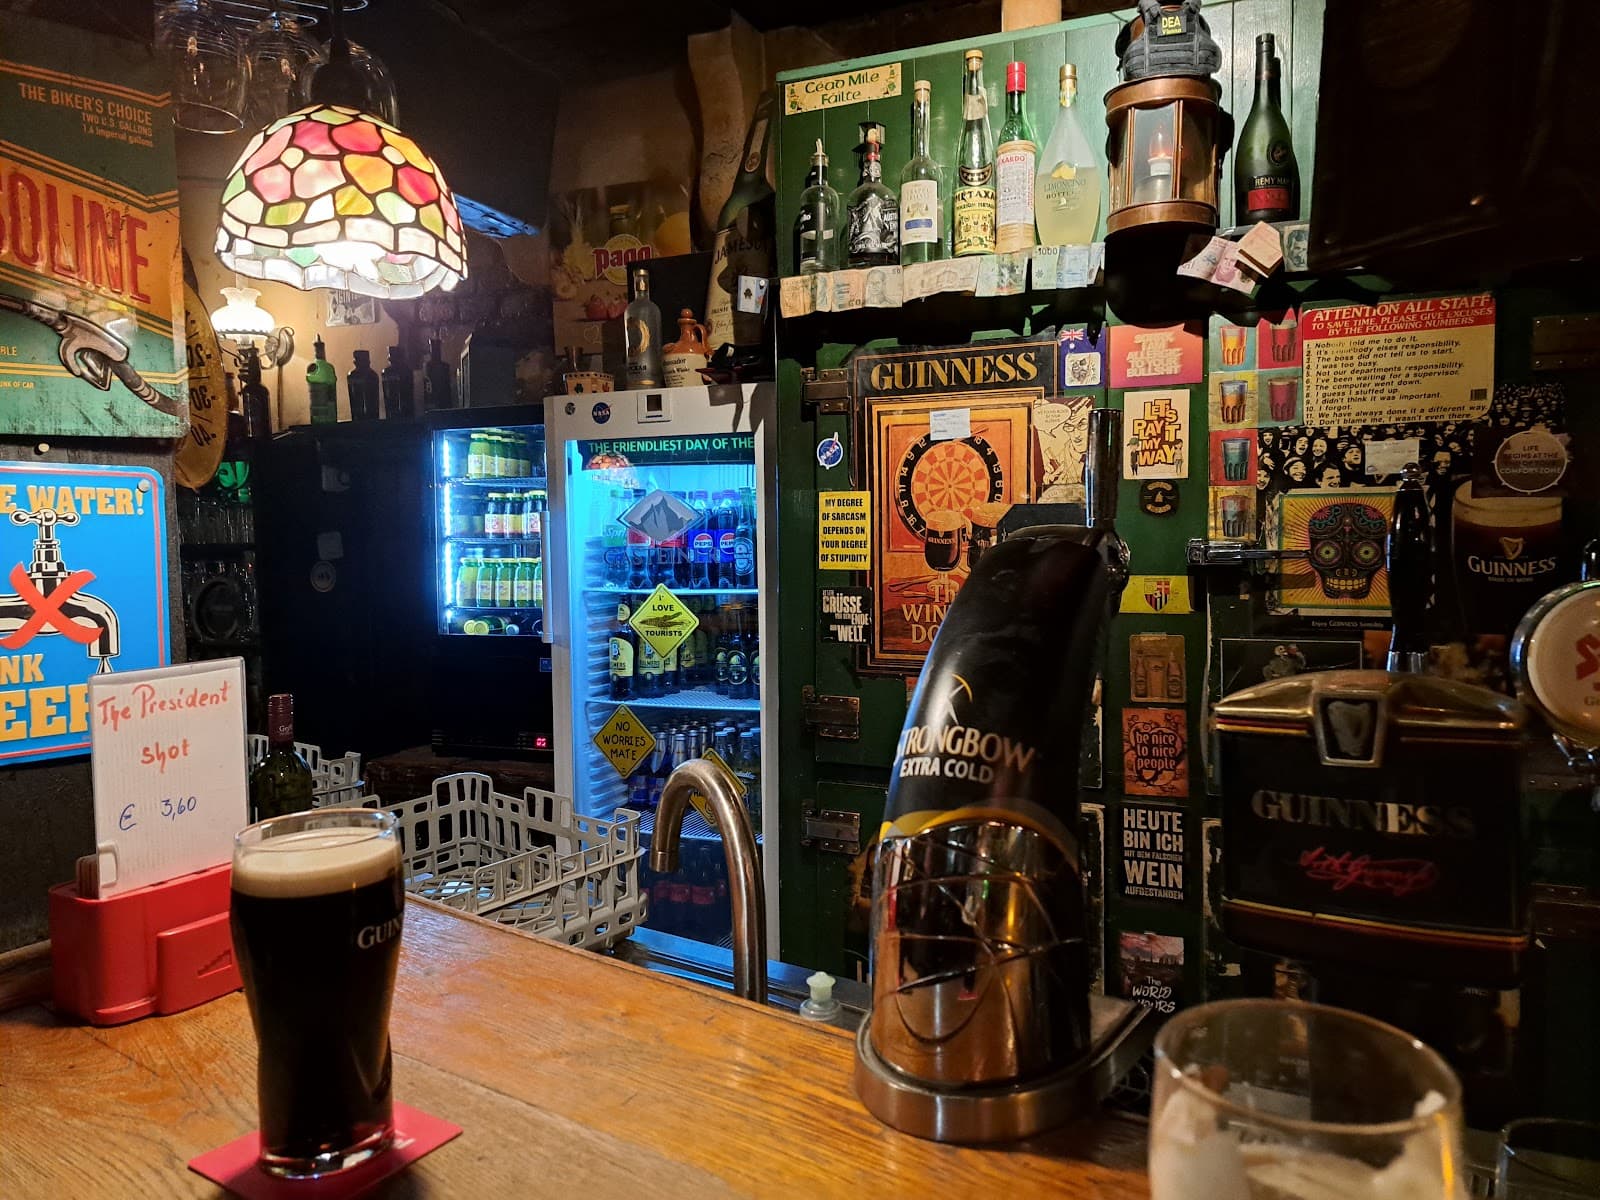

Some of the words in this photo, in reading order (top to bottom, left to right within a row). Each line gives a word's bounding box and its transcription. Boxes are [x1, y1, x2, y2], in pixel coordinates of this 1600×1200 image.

[1162, 15, 1181, 29] DEA
[18, 82, 47, 103] THE
[50, 89, 104, 114] BIKER'S
[106, 102, 153, 126] CHOICE
[82, 112, 100, 126] TWO
[118, 120, 153, 137] GALLONS
[0, 172, 151, 304] OLINE
[1313, 304, 1401, 322] ATTENTION
[1404, 300, 1435, 314] ALL
[1439, 295, 1492, 311] STAFF
[1312, 323, 1325, 331] TO
[1327, 320, 1351, 329] SAVE
[1380, 314, 1418, 324] PLEASE
[1420, 311, 1446, 321] GIVE
[1447, 307, 1494, 318] EXCUSES
[1328, 328, 1341, 337] BY
[1345, 327, 1363, 335] THE
[1366, 321, 1423, 333] FOLLOWING
[1425, 317, 1475, 328] NUMBERS
[1401, 339, 1462, 350] responsibility.
[1357, 352, 1370, 360] did
[1390, 350, 1404, 358] tell
[871, 351, 1038, 391] GUINNESS
[1350, 365, 1402, 375] departments
[1404, 361, 1465, 372] responsibility.
[1356, 373, 1386, 382] waiting
[1322, 391, 1346, 399] guess
[1355, 388, 1385, 396] stuffed
[1333, 382, 1371, 390] computer
[1144, 399, 1177, 422] LET'S
[1355, 409, 1383, 417] always
[588, 441, 610, 453] THE
[612, 439, 684, 453] FRIENDLIEST
[685, 438, 710, 451] DAY
[712, 438, 729, 449] OF
[731, 437, 755, 449] THE
[1142, 438, 1161, 450] MY
[1139, 444, 1175, 467] WAY
[27, 485, 145, 516] WATER!
[825, 499, 836, 507] MY
[837, 499, 864, 507] DEGREE
[822, 512, 831, 520] OF
[831, 512, 866, 520] SARCASM
[823, 526, 854, 534] DEPENDS
[855, 526, 866, 534] ON
[821, 540, 840, 549] YOUR
[841, 540, 867, 549] DEGREE
[821, 553, 830, 562] OF
[830, 553, 868, 562] STUPIDITY
[1467, 555, 1556, 577] GUINNESS
[652, 604, 675, 612] LOVE
[822, 592, 863, 614] GRÜSSE
[851, 613, 870, 625] ENDE
[1329, 620, 1359, 628] GUINNESS
[837, 624, 867, 642] WELT.
[131, 679, 233, 719] President
[615, 721, 631, 732] NO
[602, 734, 647, 747] WORRIES
[1136, 731, 1150, 745] be
[1151, 732, 1175, 745] nice
[141, 740, 192, 773] shot
[610, 748, 637, 761] MATE
[898, 725, 1036, 773] TRONGBOW
[1151, 744, 1175, 757] nice
[900, 757, 941, 778] EXTRA
[943, 758, 995, 785] COLD
[1136, 757, 1176, 772] people
[119, 804, 138, 831] €
[161, 795, 197, 821] 3,60
[1123, 807, 1183, 833] HEUTE
[1251, 788, 1474, 839] GUINNESS
[1123, 829, 1151, 849] BIN
[1155, 832, 1183, 852] ICH
[1123, 859, 1183, 889] WEIN
[1124, 885, 1185, 900] AUFGESTANDEN
[1145, 976, 1162, 986] The
[1131, 985, 1173, 999] WORLD
